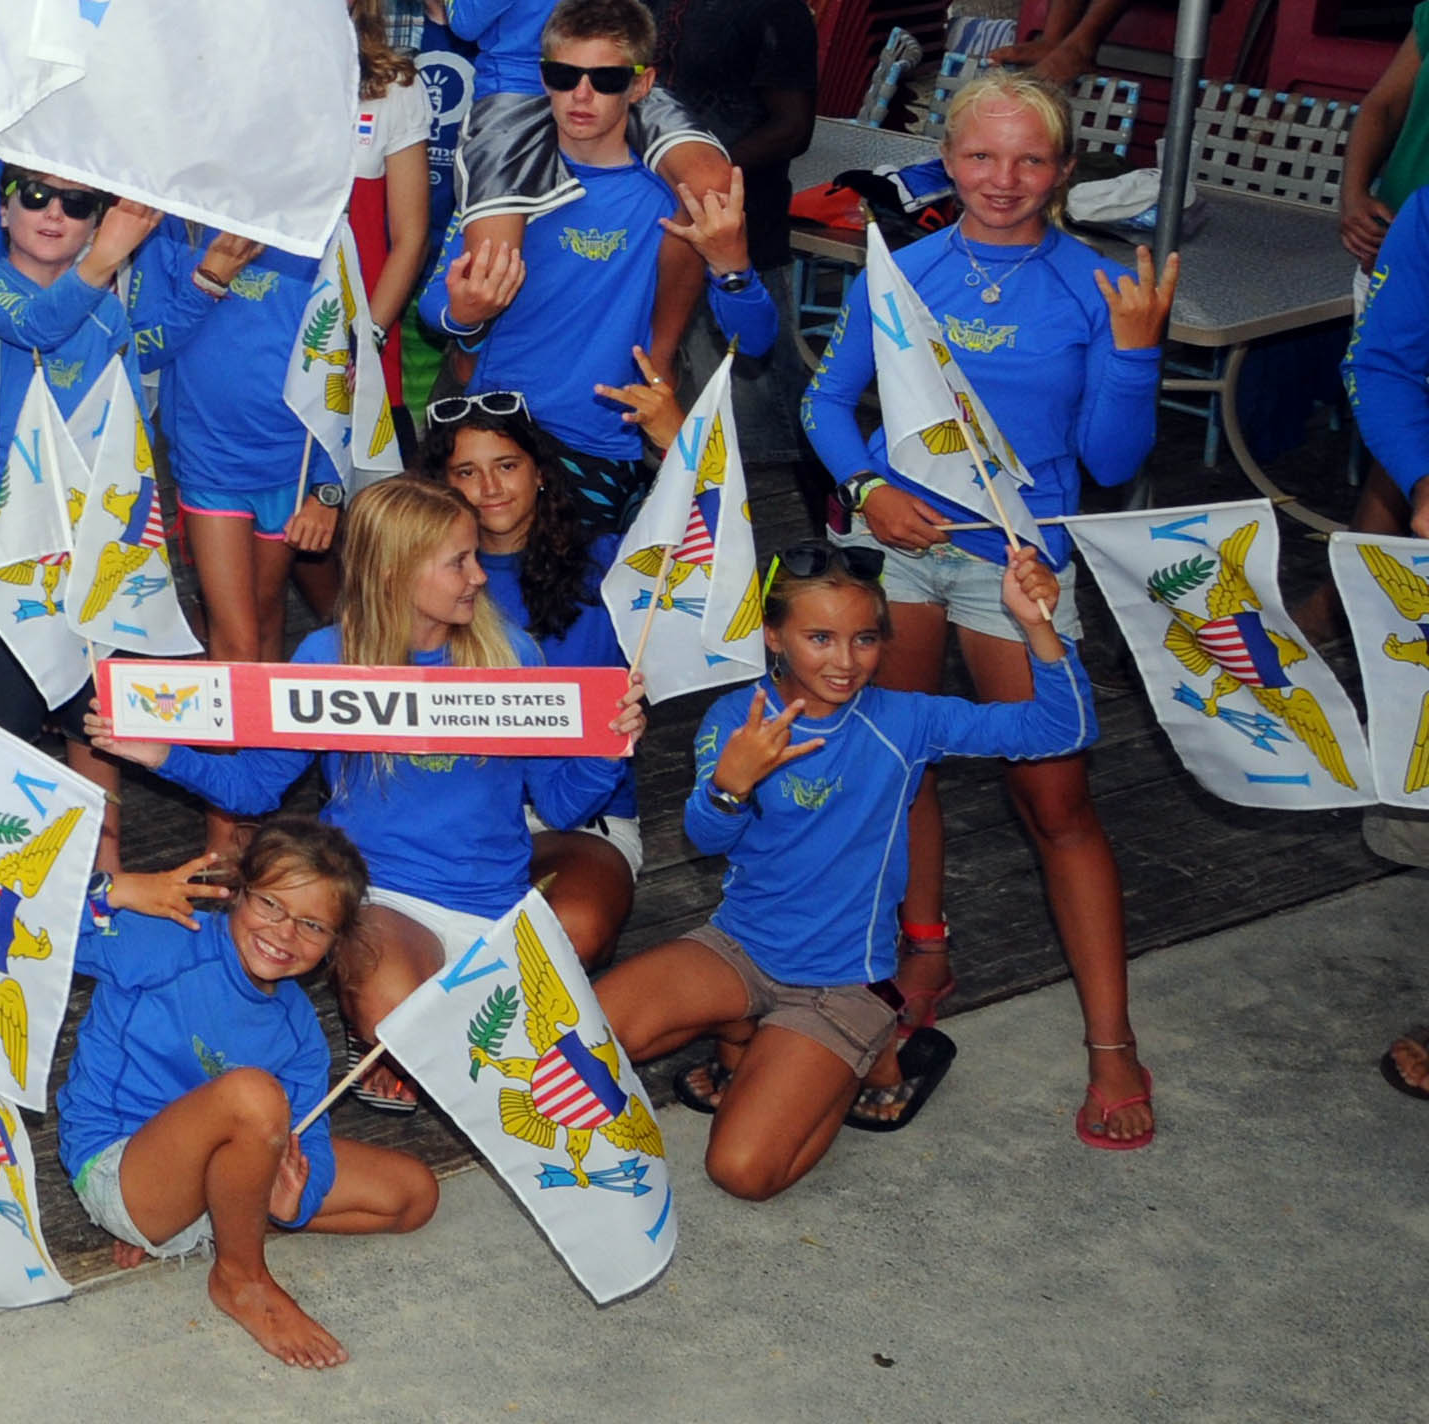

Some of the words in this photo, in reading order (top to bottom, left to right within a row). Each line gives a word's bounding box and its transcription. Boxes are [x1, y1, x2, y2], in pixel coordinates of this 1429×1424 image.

[869, 290, 914, 352] V
[288, 688, 420, 727] USVI
[431, 692, 497, 708] UNITED
[500, 693, 567, 708] STATES
[429, 712, 492, 727] VIRGIN
[495, 714, 571, 729] ISLANDS
